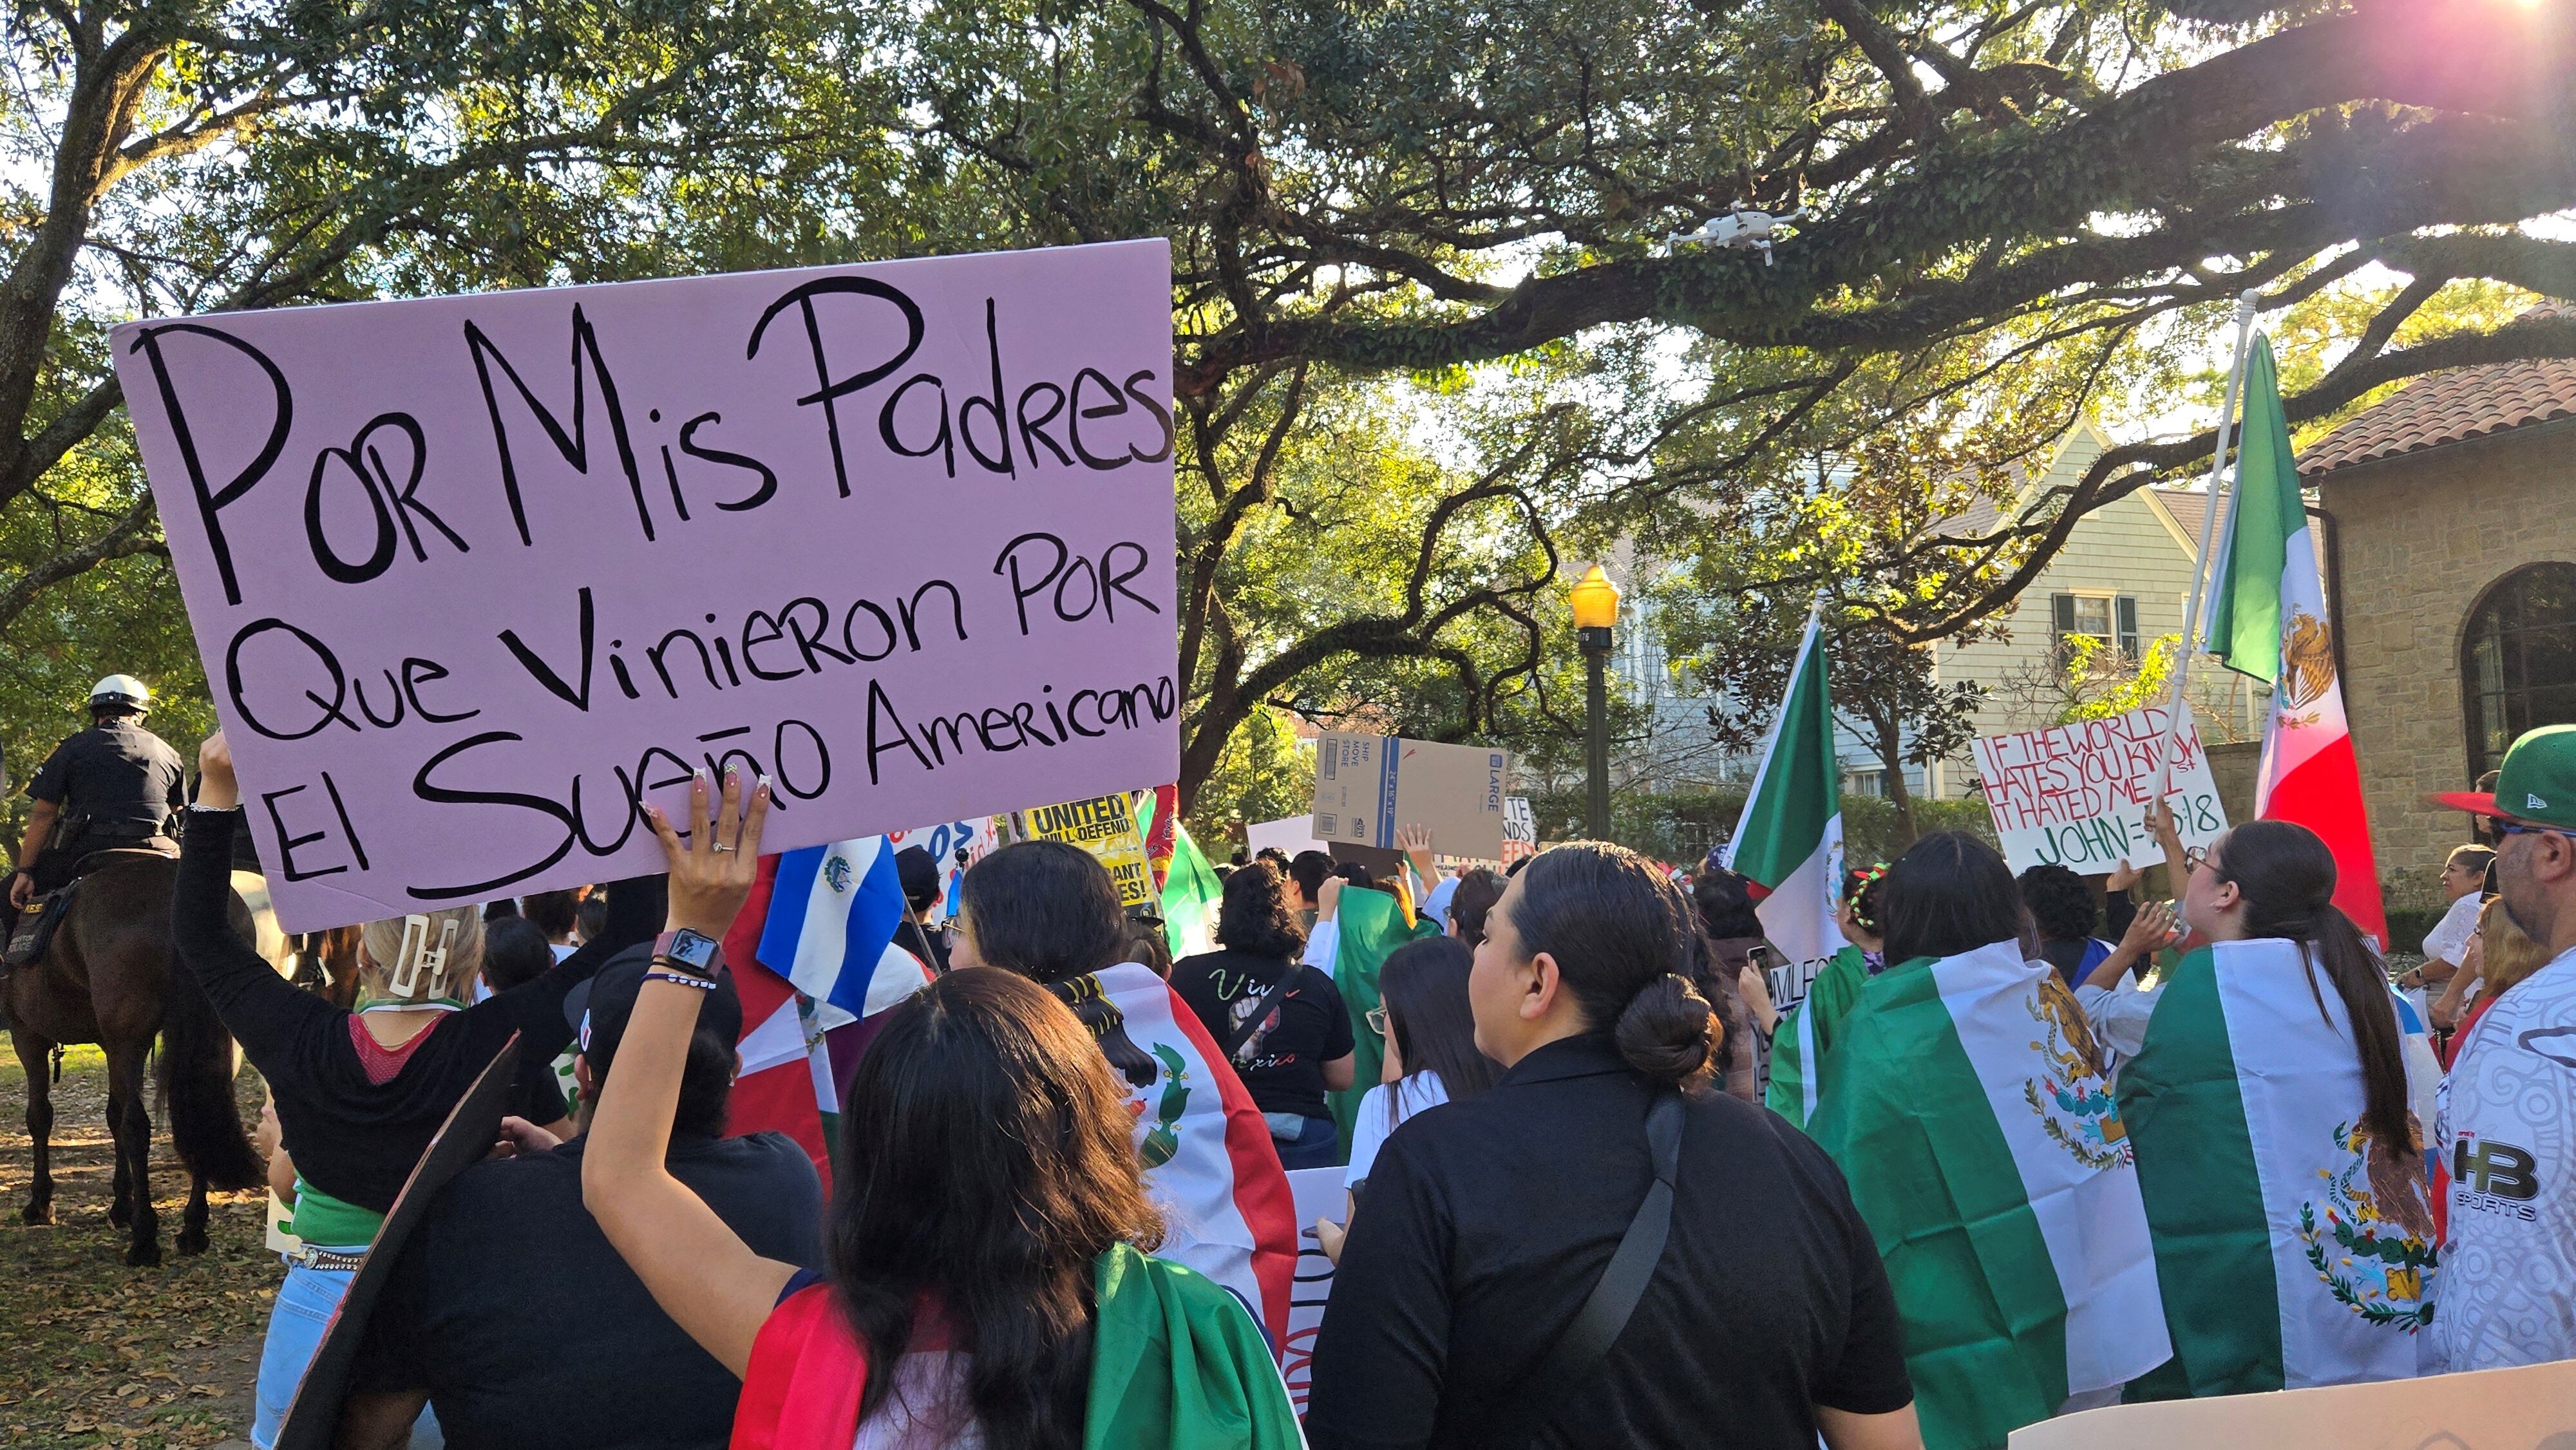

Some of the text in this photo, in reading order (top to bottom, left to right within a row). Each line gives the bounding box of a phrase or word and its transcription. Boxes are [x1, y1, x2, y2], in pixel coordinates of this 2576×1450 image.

[463, 301, 778, 547] Mis
[225, 617, 482, 741] Que
[1341, 740, 1350, 768] STORE
[1351, 741, 1360, 767] MOVE
[1361, 742, 1370, 762] SHIP
[1982, 708, 2170, 769] IF THE WORLD
[1980, 723, 2202, 804] HATES YOU KNOW
[1488, 769, 1501, 813] LARGE
[1990, 802, 2012, 833] IT
[2014, 786, 2102, 830] HATED
[2108, 773, 2153, 812] ME
[1032, 794, 1126, 834] UNITED
[1504, 797, 1529, 821] TE
[1076, 818, 1130, 842] DEFEND
[1502, 821, 1531, 842] NDS
[2035, 814, 2130, 867] JOHN
[2144, 794, 2220, 849] :18
[1105, 862, 1141, 882] ANT
[1208, 968, 1301, 1001] Viv
[1231, 1053, 1296, 1072] exico
[2454, 1138, 2539, 1200] HB
[2455, 1191, 2537, 1222] SPORTS
